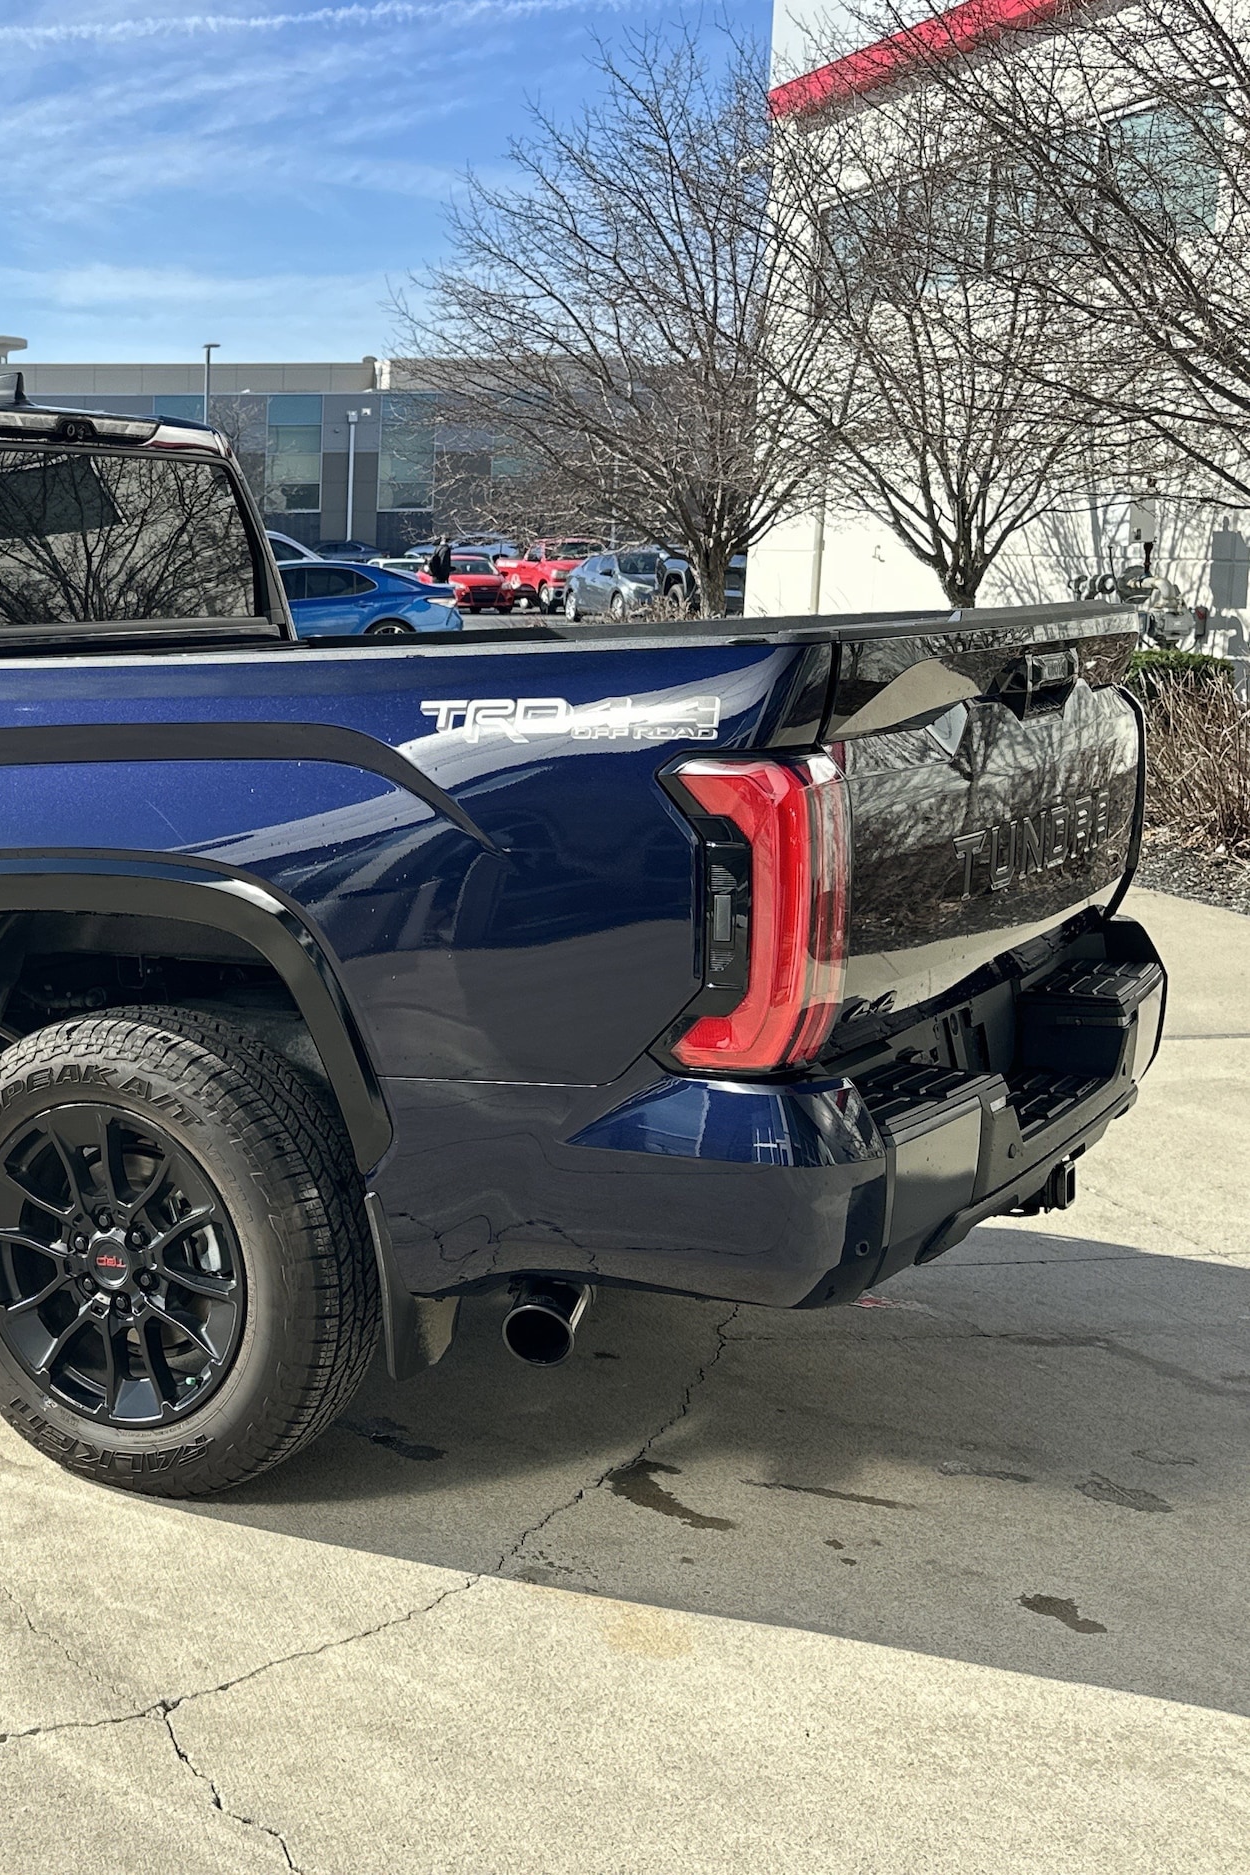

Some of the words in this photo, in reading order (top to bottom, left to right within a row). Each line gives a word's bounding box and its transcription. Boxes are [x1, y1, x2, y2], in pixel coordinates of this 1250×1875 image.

[420, 697, 575, 744] TRD
[573, 695, 720, 730] 44
[570, 726, 629, 741] OFF
[632, 726, 719, 741] ROAD
[952, 791, 1110, 902] TUNDRA
[117, 1076, 205, 1127] A/T
[9, 1395, 216, 1474] FALKEN
